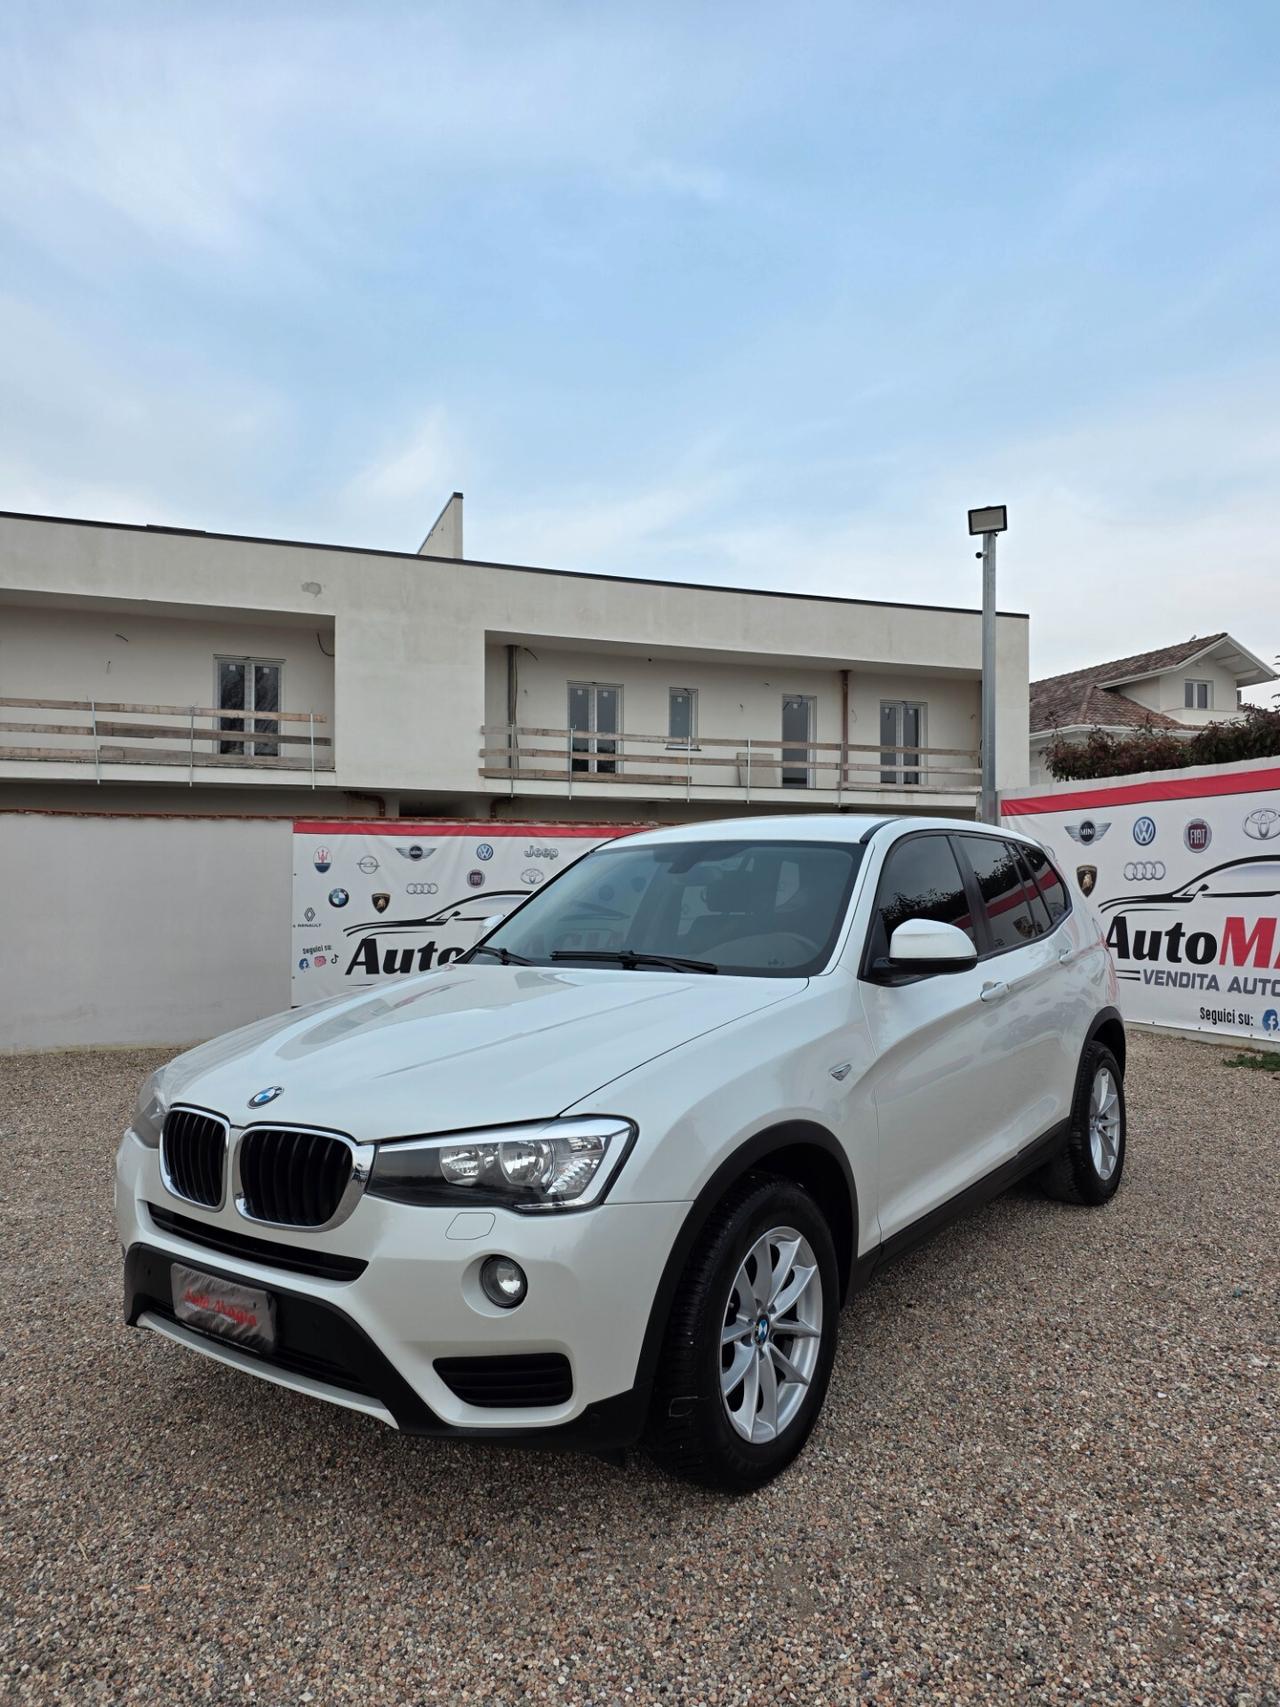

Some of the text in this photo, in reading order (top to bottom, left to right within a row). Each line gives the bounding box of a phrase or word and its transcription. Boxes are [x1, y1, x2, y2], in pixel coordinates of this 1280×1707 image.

[1190, 829, 1206, 844] FIAT
[523, 845, 559, 860] Jeep
[1106, 916, 1280, 969] AutoM
[1143, 969, 1220, 992] VENDITA
[1200, 1006, 1254, 1026] Seguici su:
